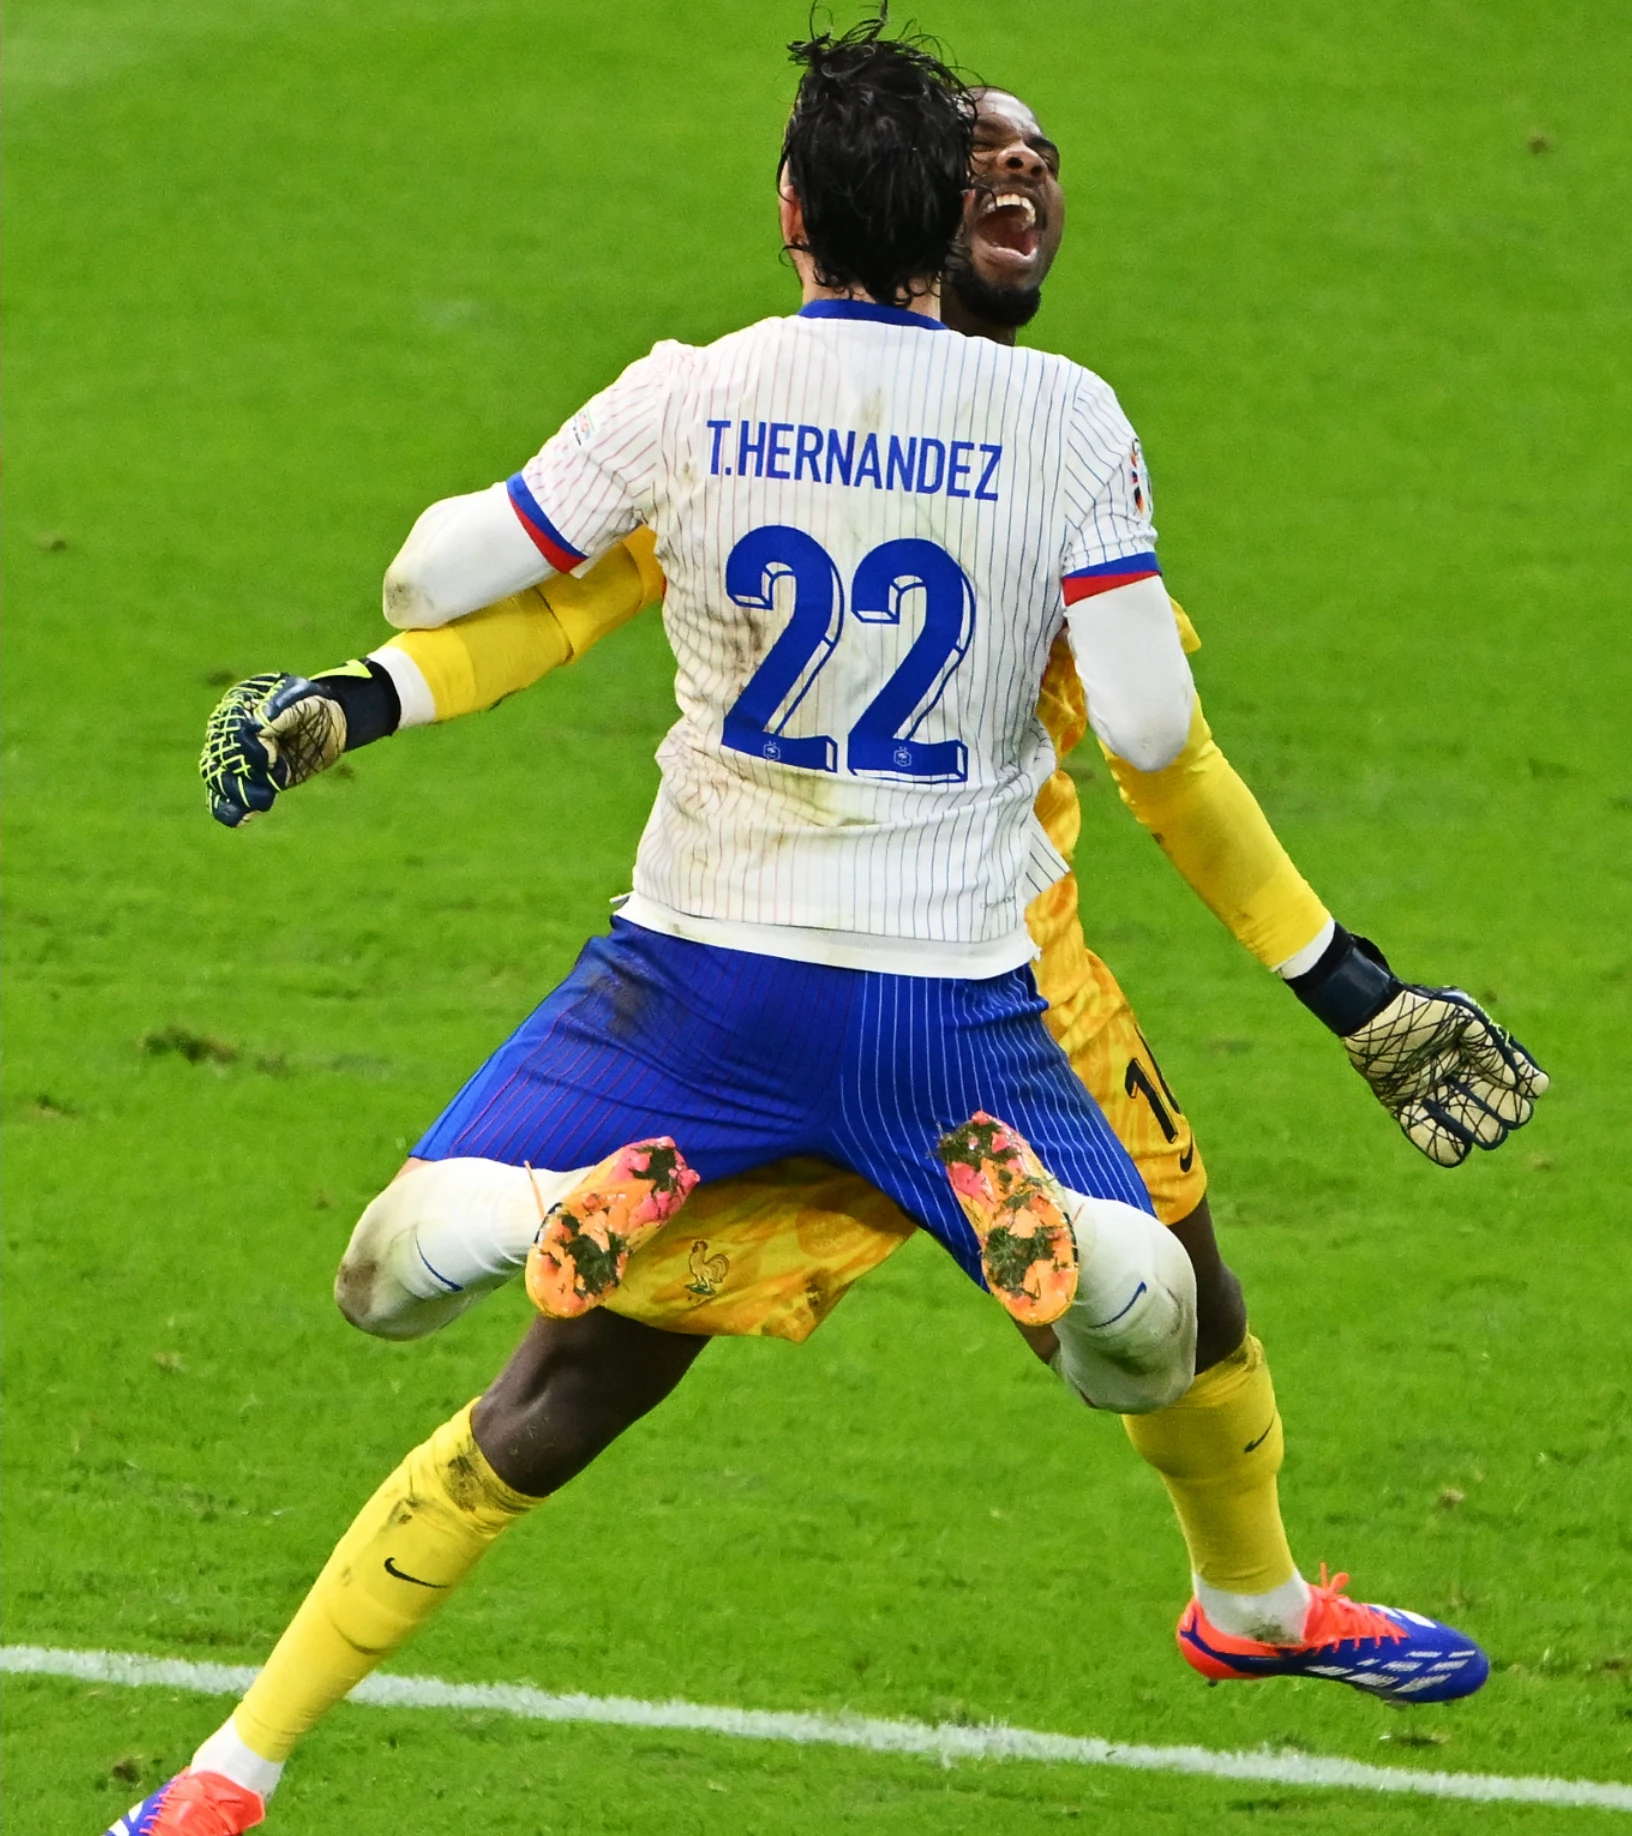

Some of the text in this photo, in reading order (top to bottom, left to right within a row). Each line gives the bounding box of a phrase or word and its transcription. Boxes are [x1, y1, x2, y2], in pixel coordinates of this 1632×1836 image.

[706, 419, 1003, 502] T.HERNANDEZ
[721, 524, 976, 784] 22
[1125, 1022, 1181, 1144] 1
